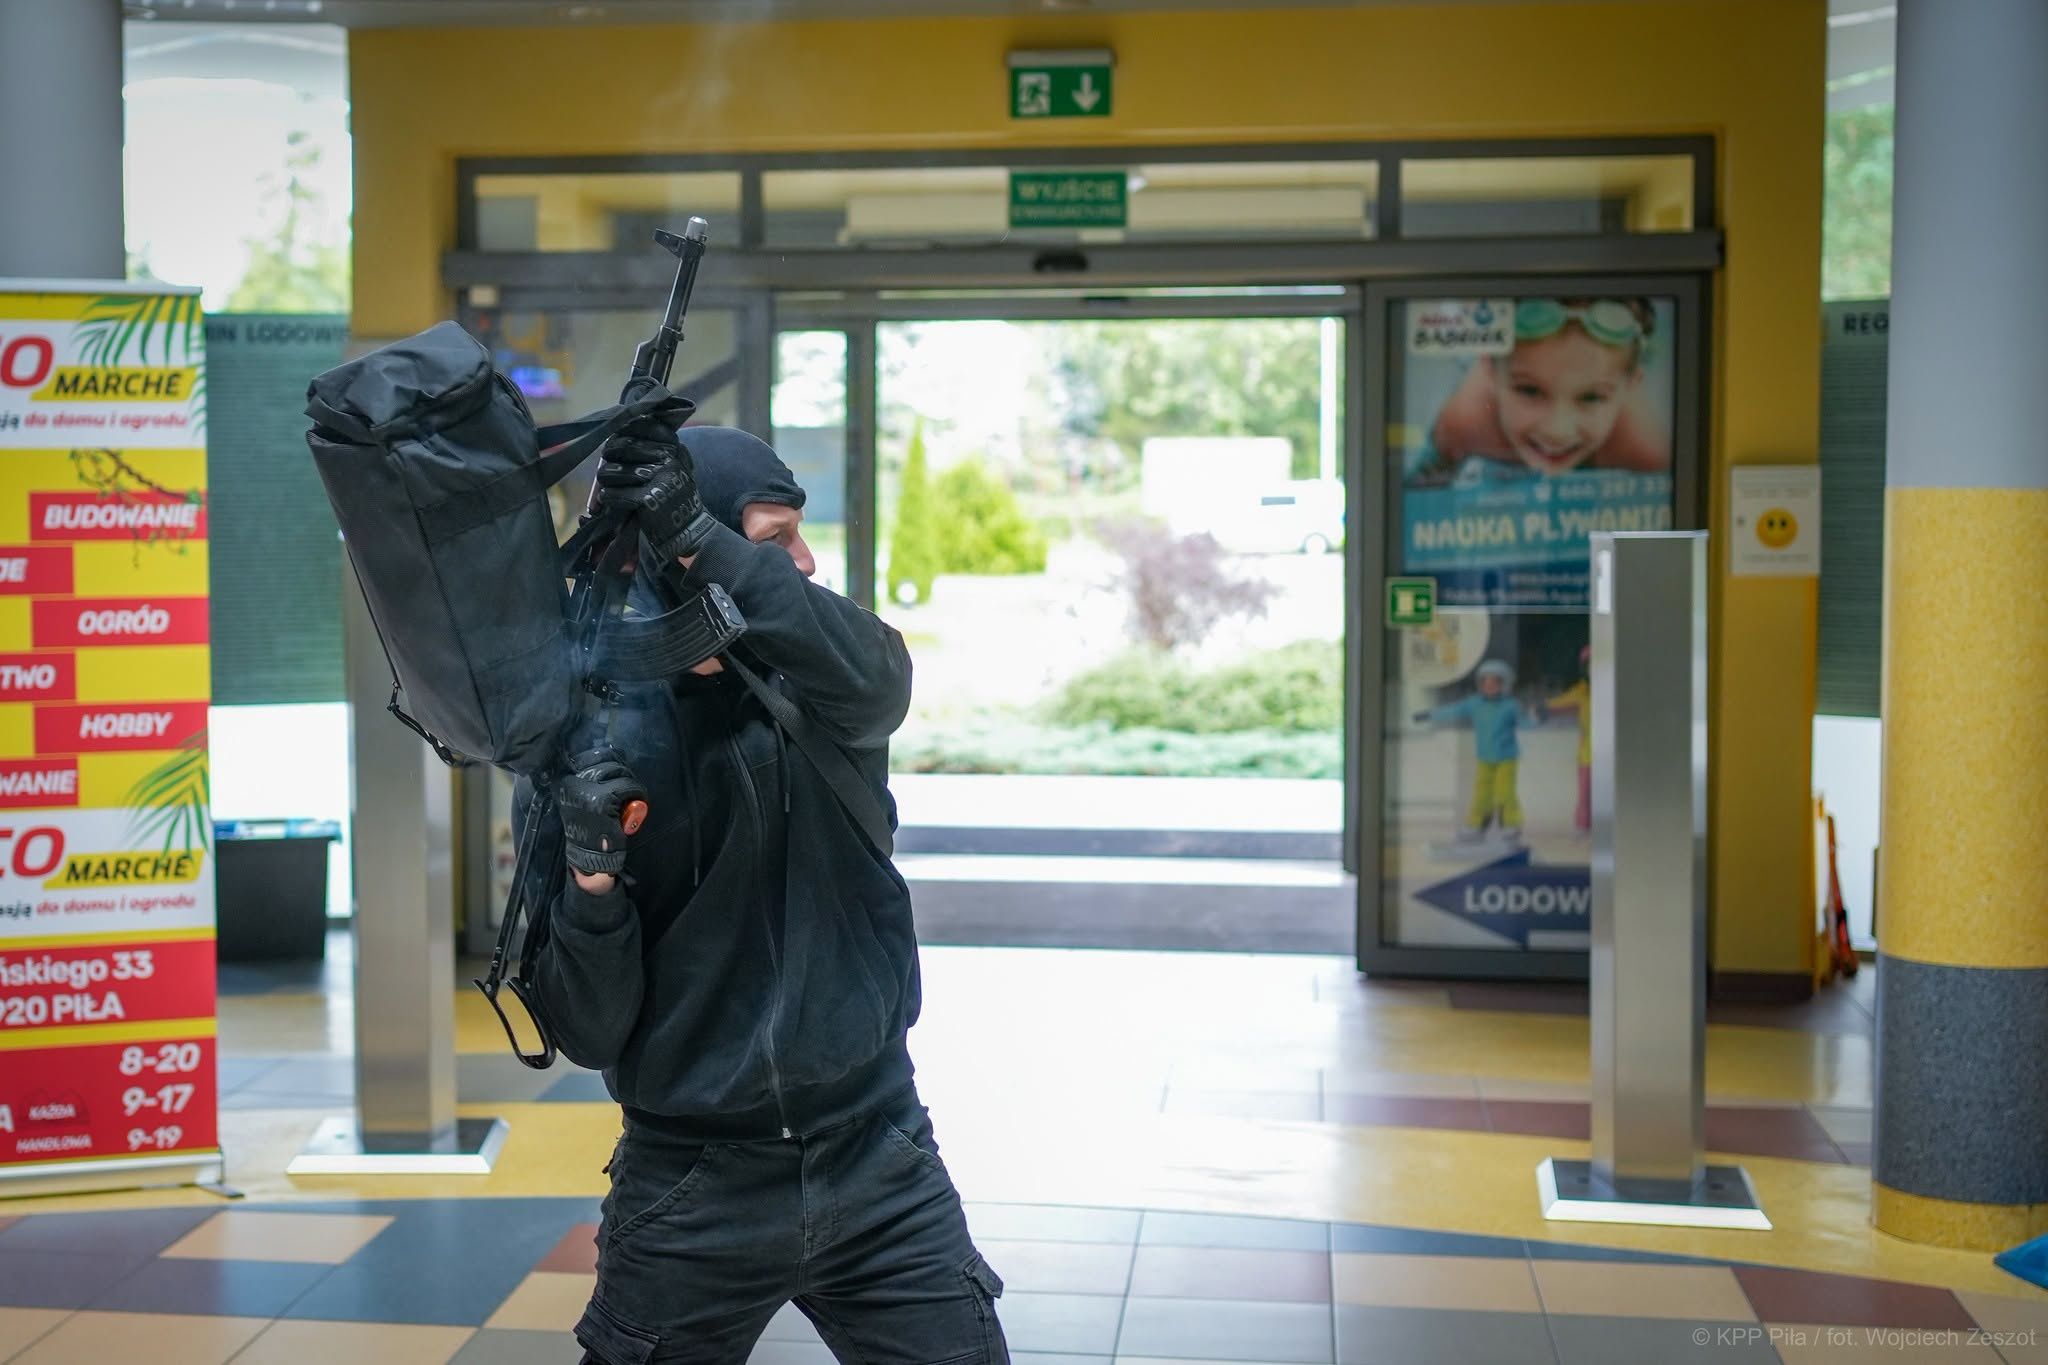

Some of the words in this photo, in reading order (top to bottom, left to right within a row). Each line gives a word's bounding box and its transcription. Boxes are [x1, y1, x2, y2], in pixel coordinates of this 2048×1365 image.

[0, 334, 54, 388] O
[24, 411, 48, 428] do
[53, 411, 106, 428] domu
[120, 410, 188, 430] ogrodu
[43, 503, 199, 529] BUDOWANIE
[1412, 513, 1517, 549] NAUKA
[77, 603, 170, 636] OGRÓD
[79, 711, 173, 739] HOBBY
[36, 898, 59, 915] do
[63, 897, 116, 914] domu
[129, 892, 196, 913] ogrodu
[111, 949, 155, 980] 33
[0, 994, 48, 1026] 20
[52, 990, 126, 1023] PIŁA
[119, 1041, 201, 1076] 8-20
[122, 1083, 195, 1117] 9-17
[127, 1125, 183, 1151] 9-19
